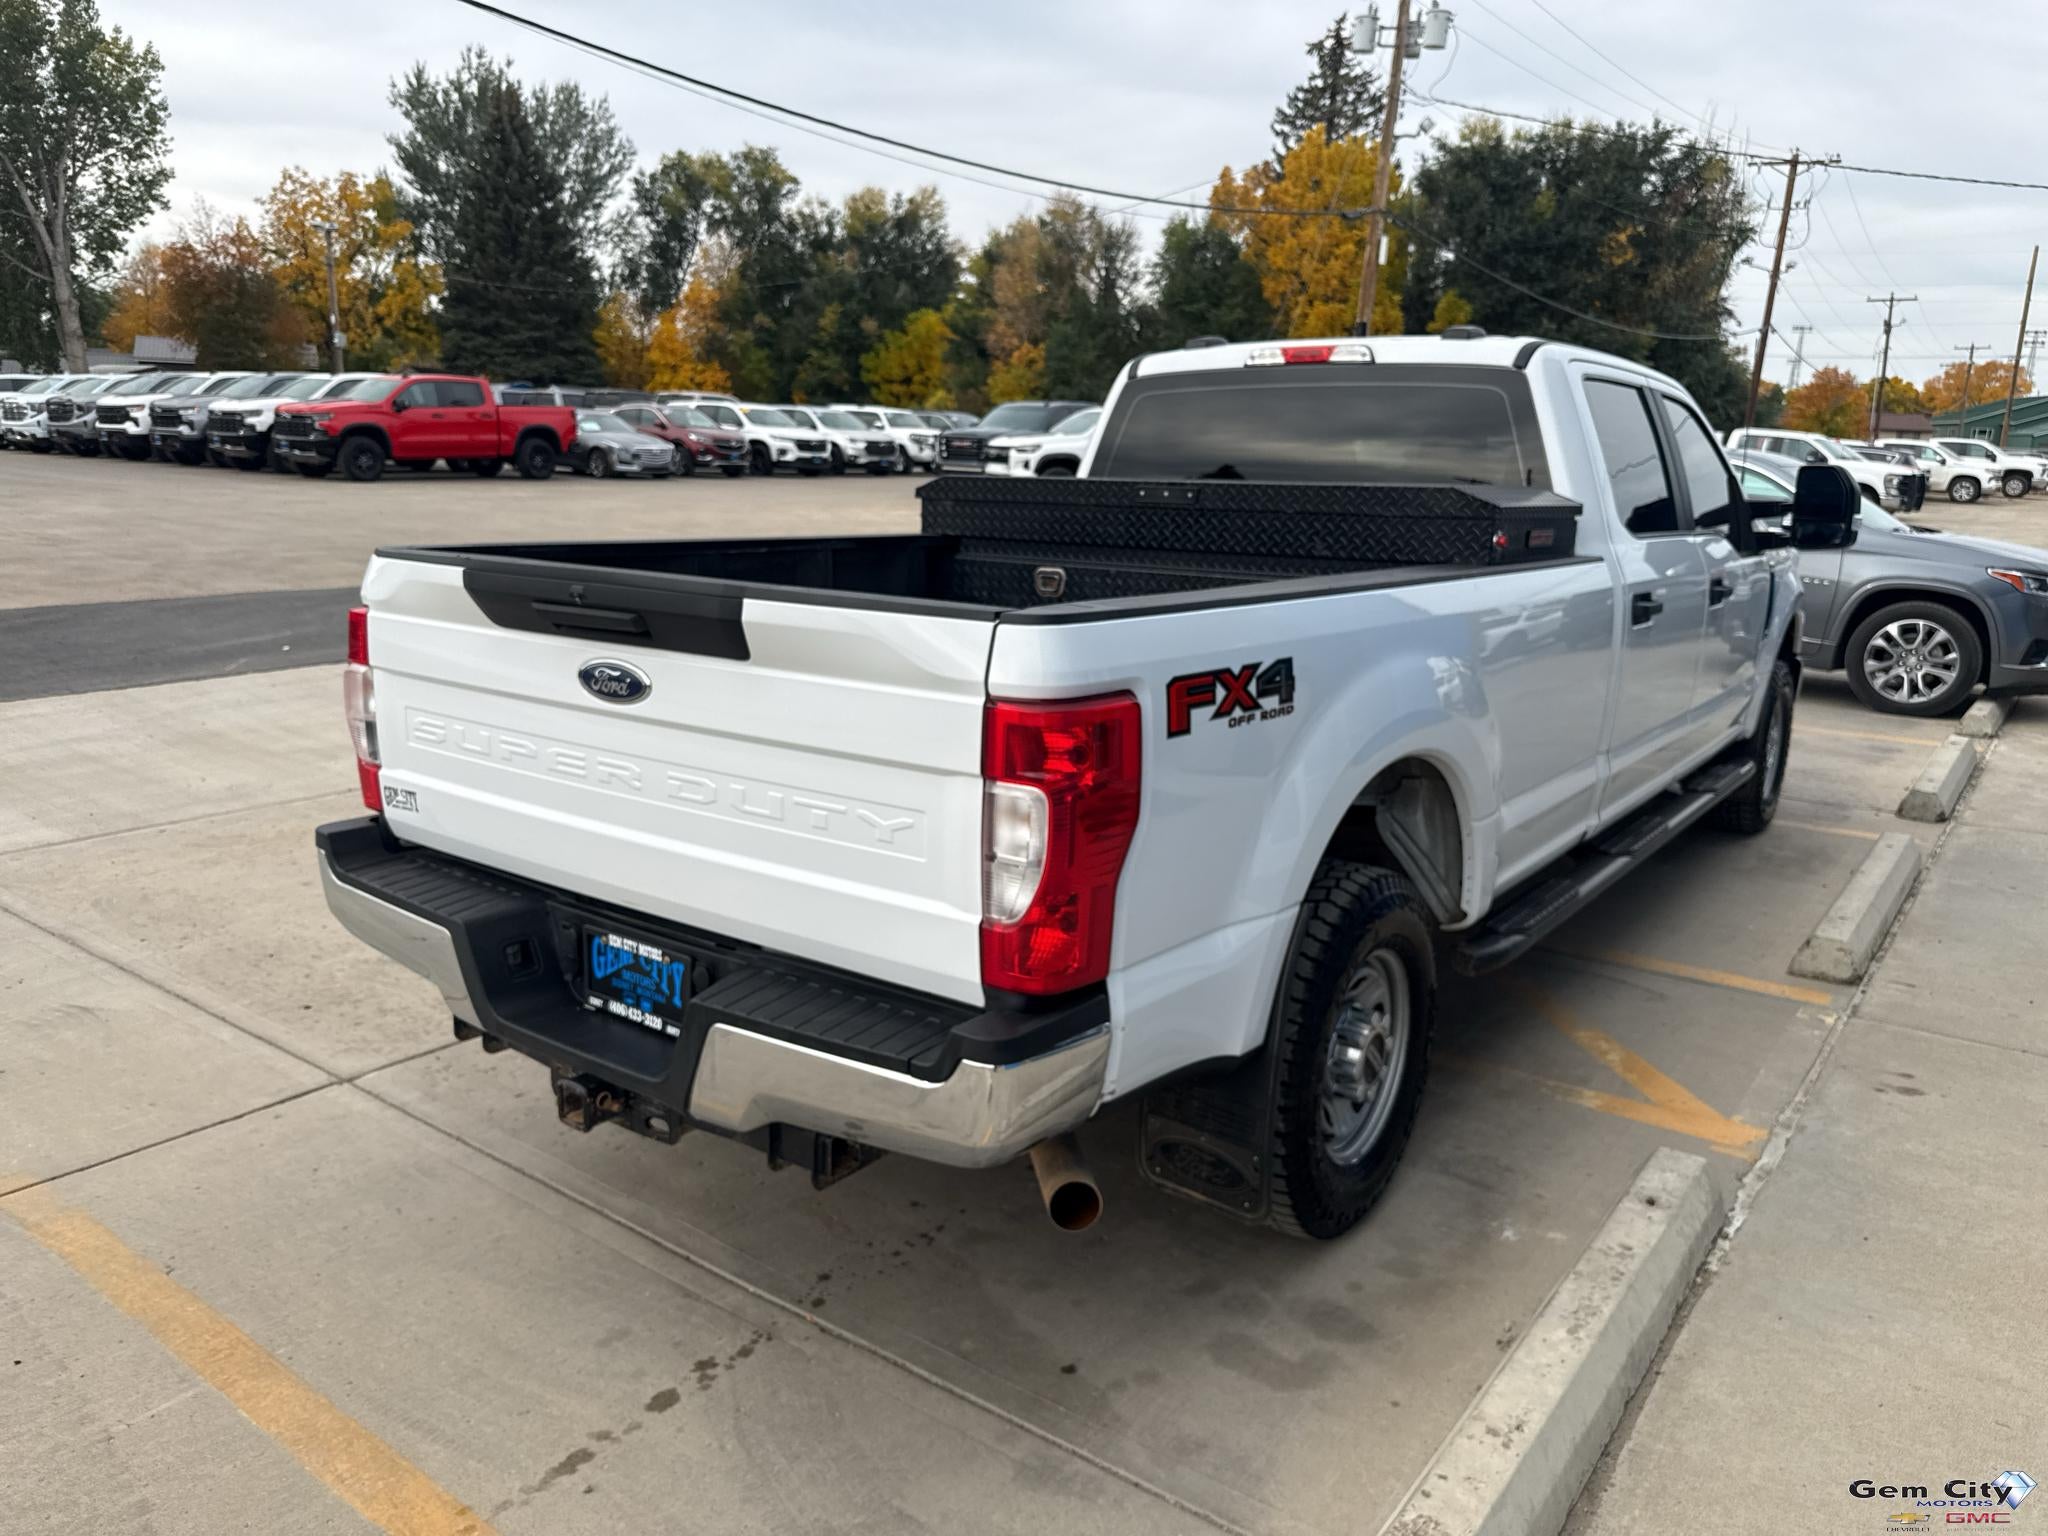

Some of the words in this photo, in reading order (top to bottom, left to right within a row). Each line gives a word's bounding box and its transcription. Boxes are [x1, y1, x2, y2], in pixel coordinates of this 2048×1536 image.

[591, 666, 631, 696] Ford
[1166, 656, 1295, 739] FX4
[1228, 713, 1256, 728] OFF
[1260, 705, 1295, 721] ROAD
[411, 716, 642, 790] SUPER
[667, 771, 914, 844] DUTY
